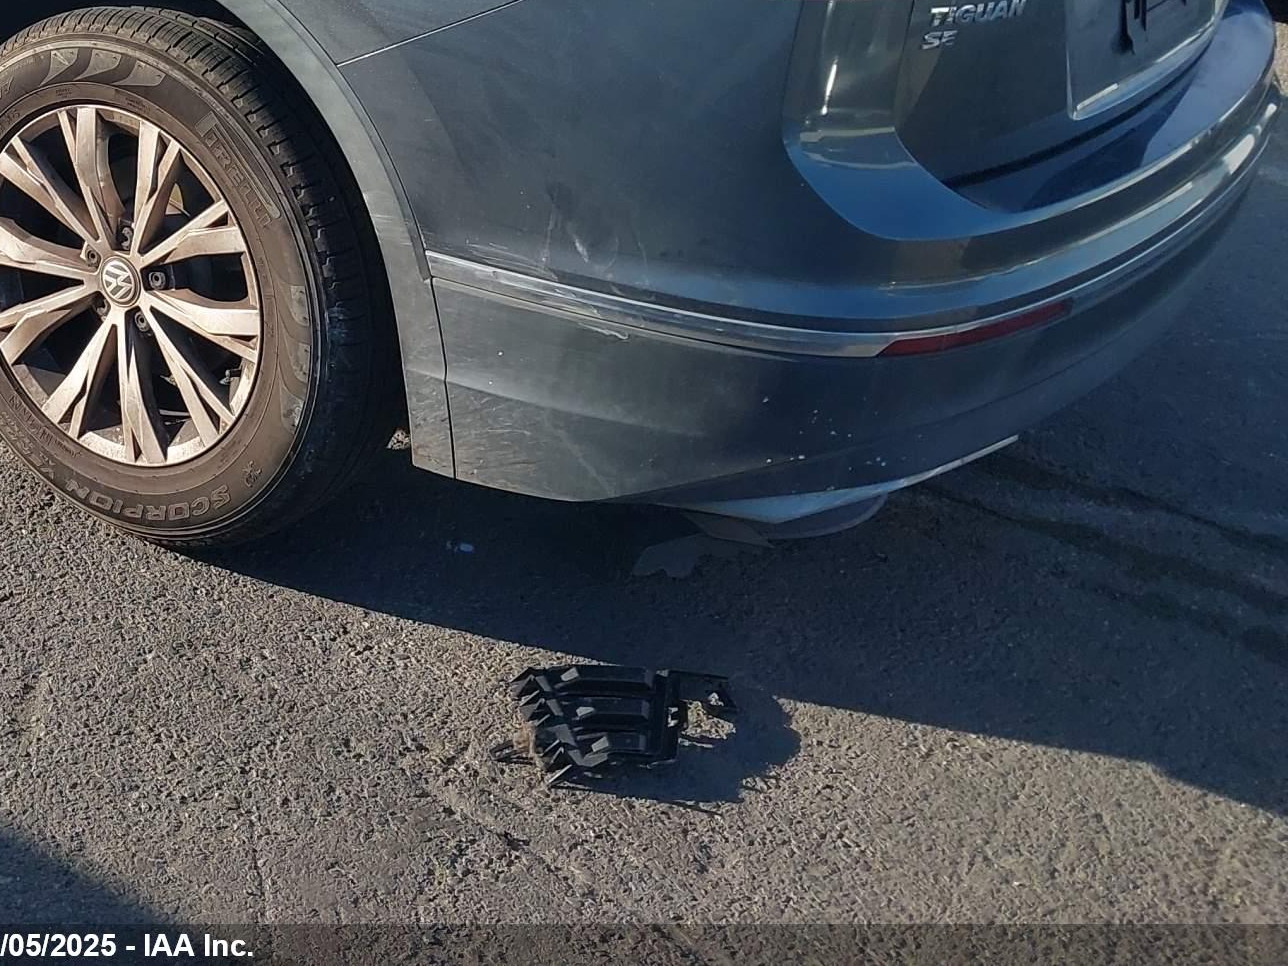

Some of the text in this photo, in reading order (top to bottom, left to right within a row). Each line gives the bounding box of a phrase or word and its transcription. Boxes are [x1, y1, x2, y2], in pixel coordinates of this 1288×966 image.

[920, 30, 958, 50] SE
[194, 111, 281, 228] PIRELLI
[64, 477, 232, 522] SCORPION
